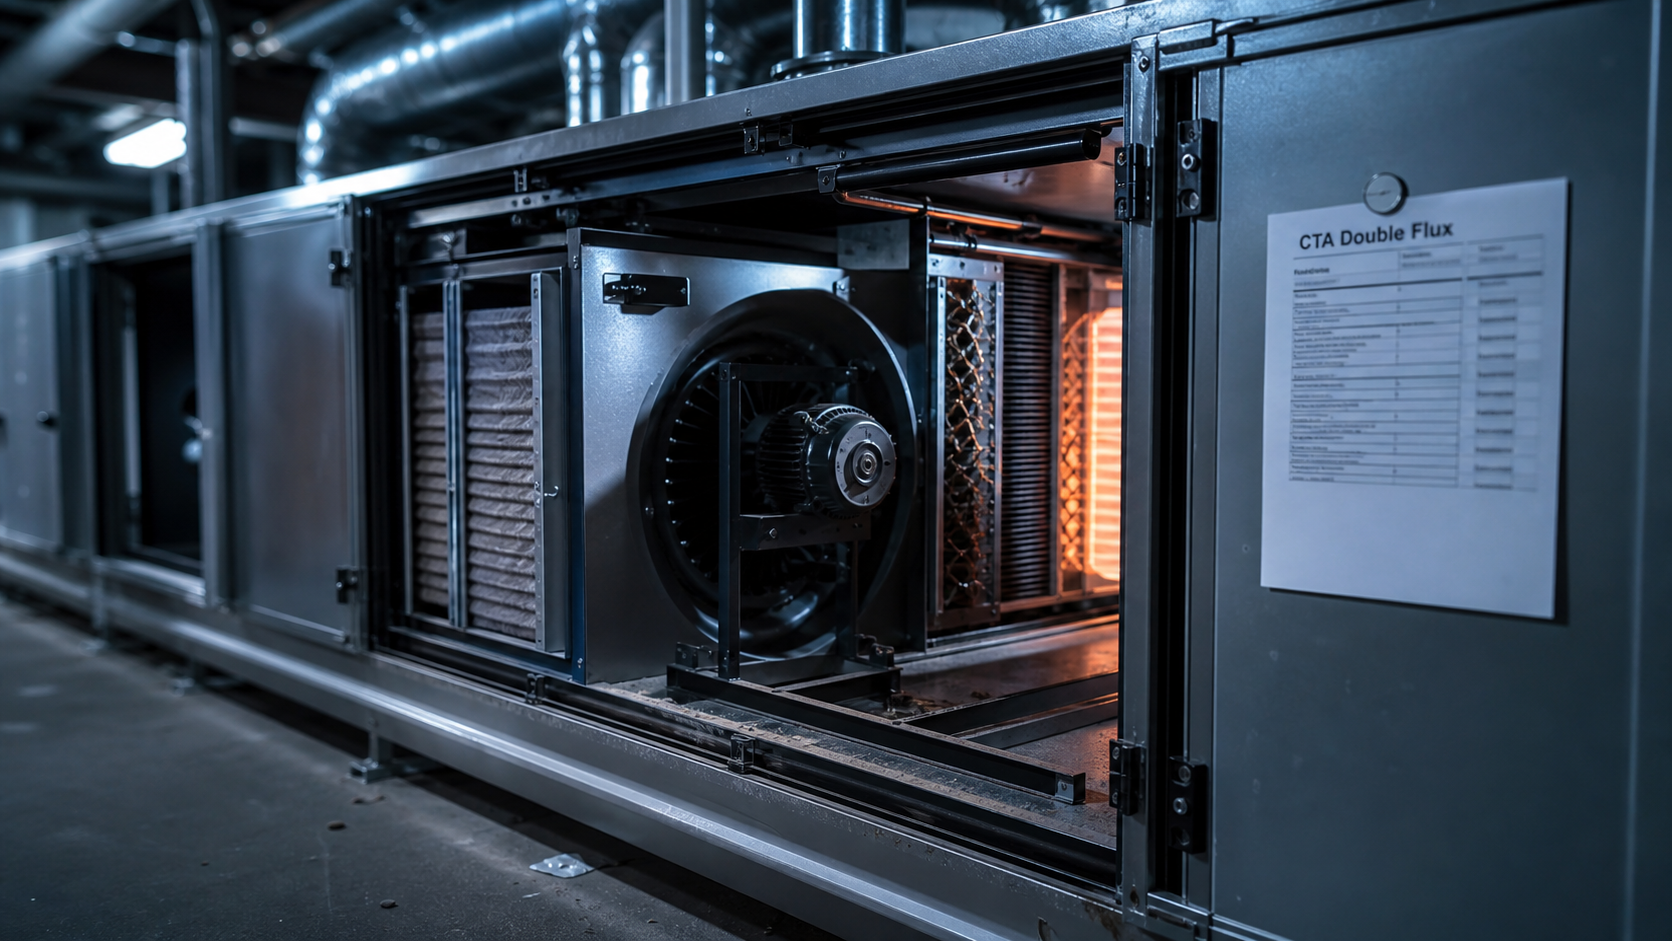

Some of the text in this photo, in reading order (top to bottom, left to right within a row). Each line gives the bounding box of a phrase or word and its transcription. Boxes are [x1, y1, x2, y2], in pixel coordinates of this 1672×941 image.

[1299, 221, 1454, 250] CTA Double Flux
